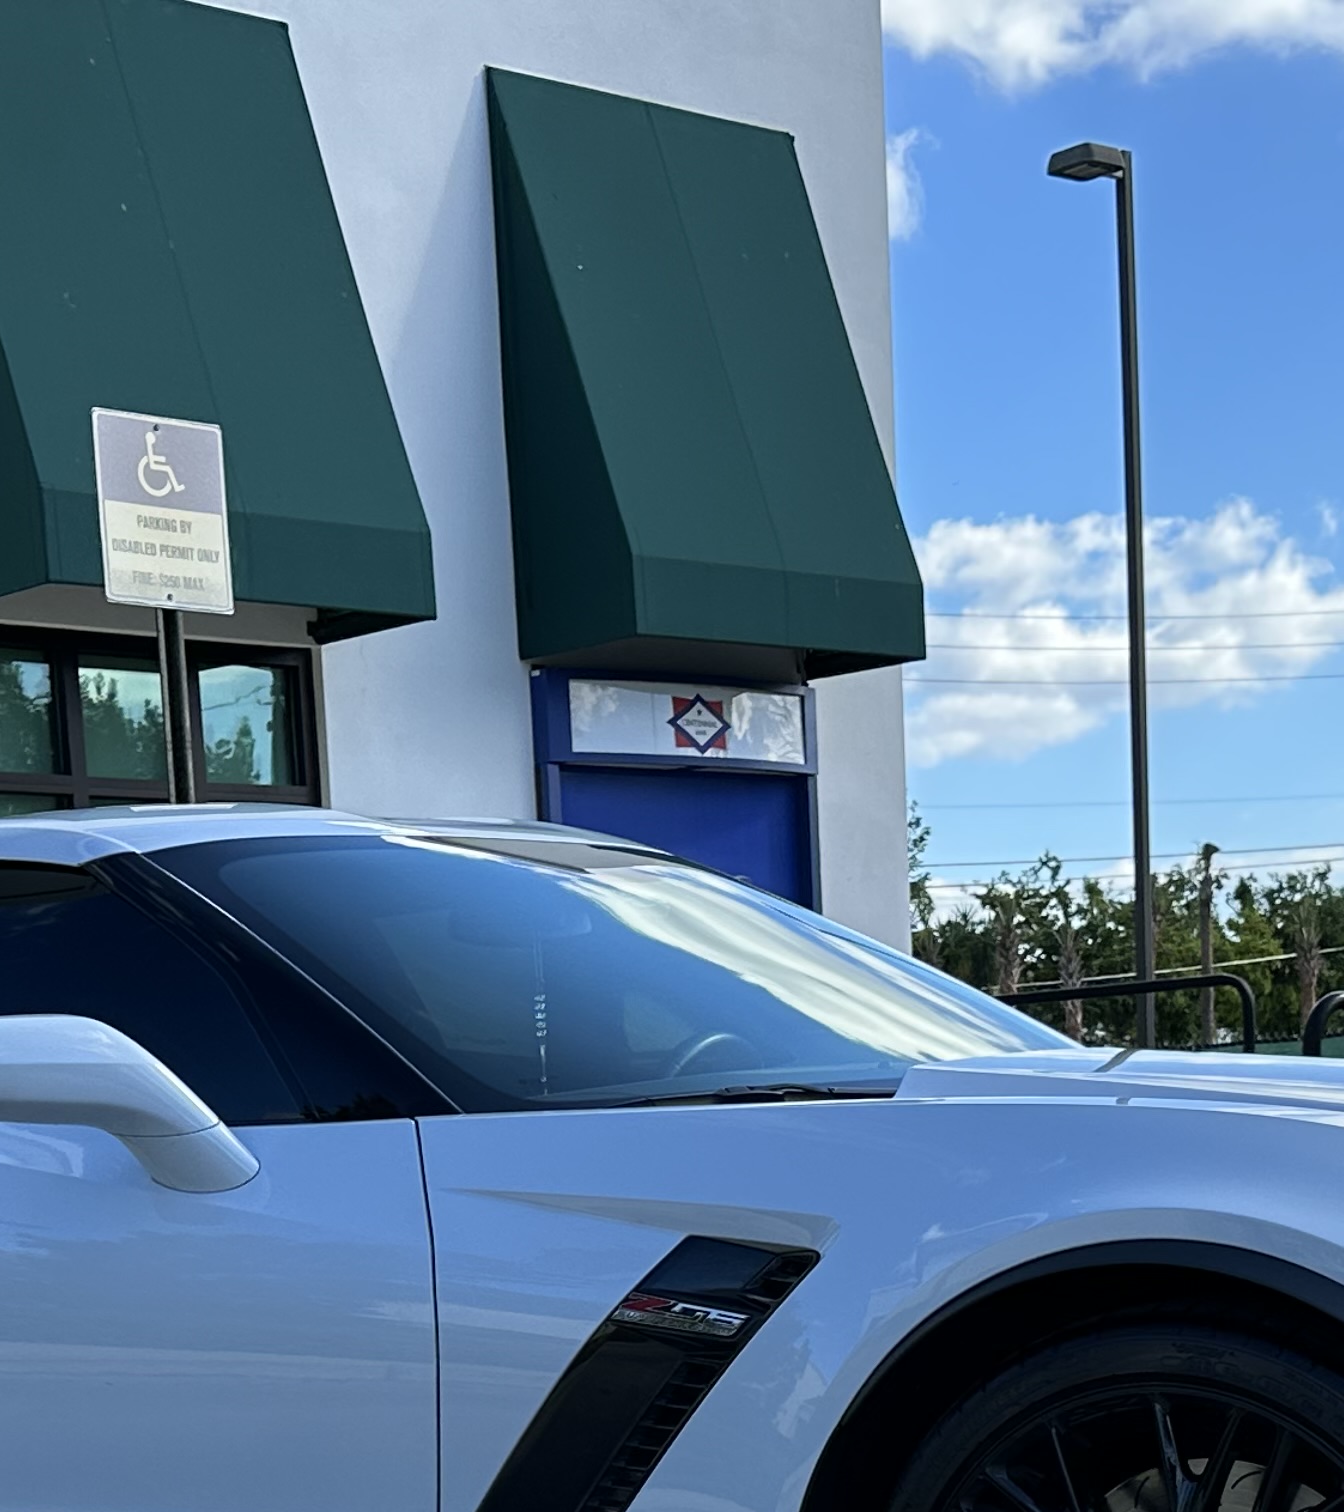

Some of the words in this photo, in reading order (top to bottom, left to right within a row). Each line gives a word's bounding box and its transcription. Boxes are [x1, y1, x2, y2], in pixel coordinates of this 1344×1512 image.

[136, 514, 177, 533] PARKING
[180, 520, 193, 535] BY
[112, 538, 157, 557] DISABLED
[159, 544, 195, 561] PERMIT
[197, 548, 220, 564] ONLY
